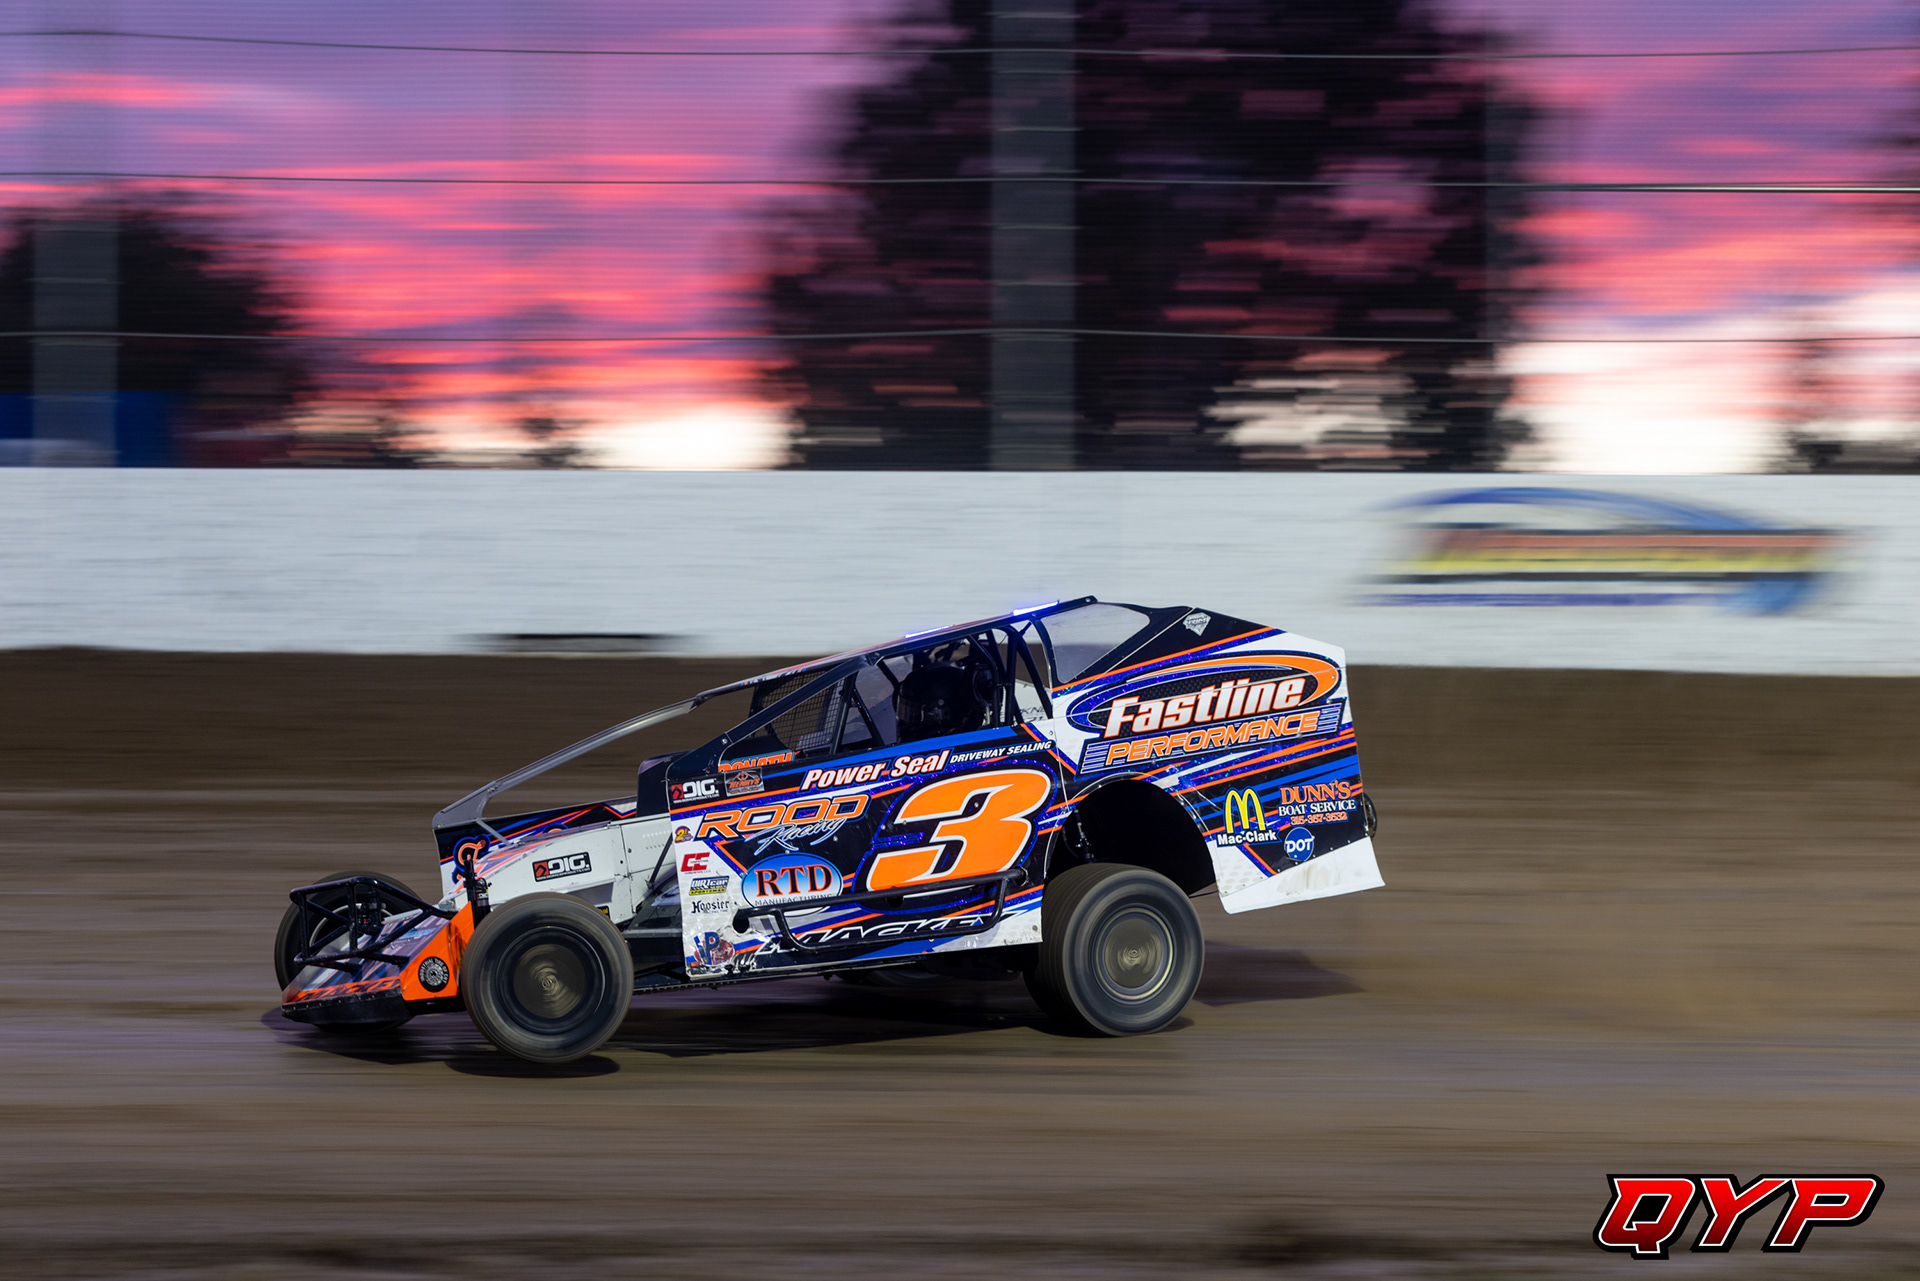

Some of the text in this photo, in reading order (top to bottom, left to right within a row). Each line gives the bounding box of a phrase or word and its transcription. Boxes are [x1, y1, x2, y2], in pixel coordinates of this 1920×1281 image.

[1104, 678, 1306, 738] Fastline
[1105, 710, 1321, 765] PERFORMANCE
[800, 741, 1052, 791] Power Seal DRIVEWAY SEALING
[1278, 799, 1357, 817] BOAT SERVICE
[1280, 779, 1352, 804] DUNN'S
[697, 794, 870, 838] ROOD
[745, 816, 848, 856] Racing
[866, 769, 1051, 899] 3
[1285, 835, 1315, 854] DOT
[754, 864, 833, 897] RTD
[691, 898, 730, 914] Hoosier
